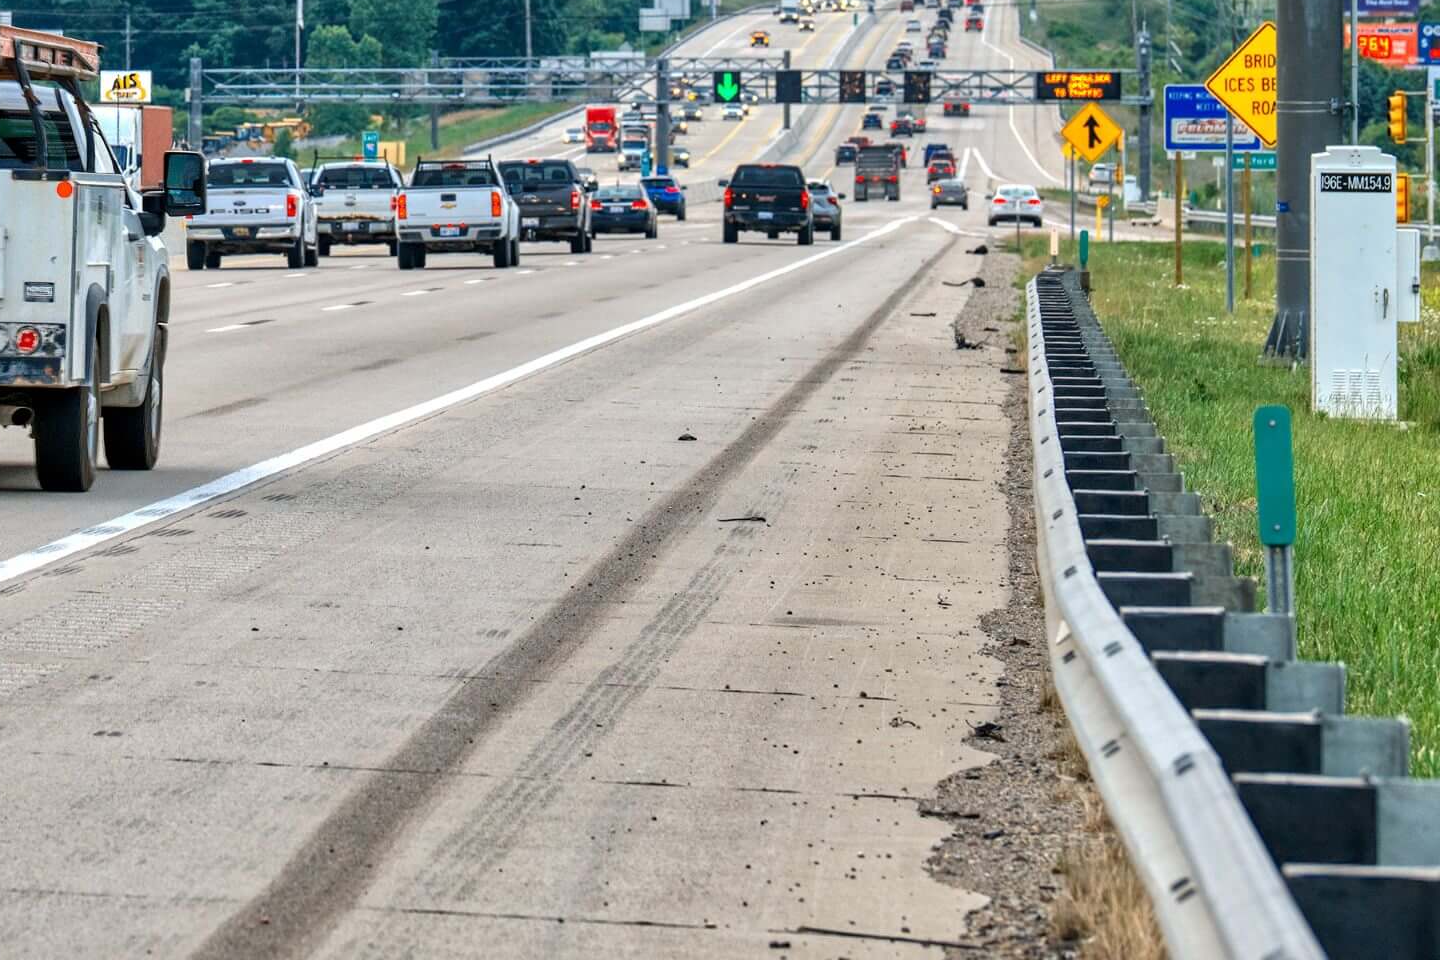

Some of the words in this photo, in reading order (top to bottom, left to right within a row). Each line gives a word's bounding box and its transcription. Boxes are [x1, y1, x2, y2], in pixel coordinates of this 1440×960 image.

[1224, 78, 1255, 92] ICES
[1236, 157, 1274, 166] Mford
[1321, 175, 1391, 190] I96E-MM154.9
